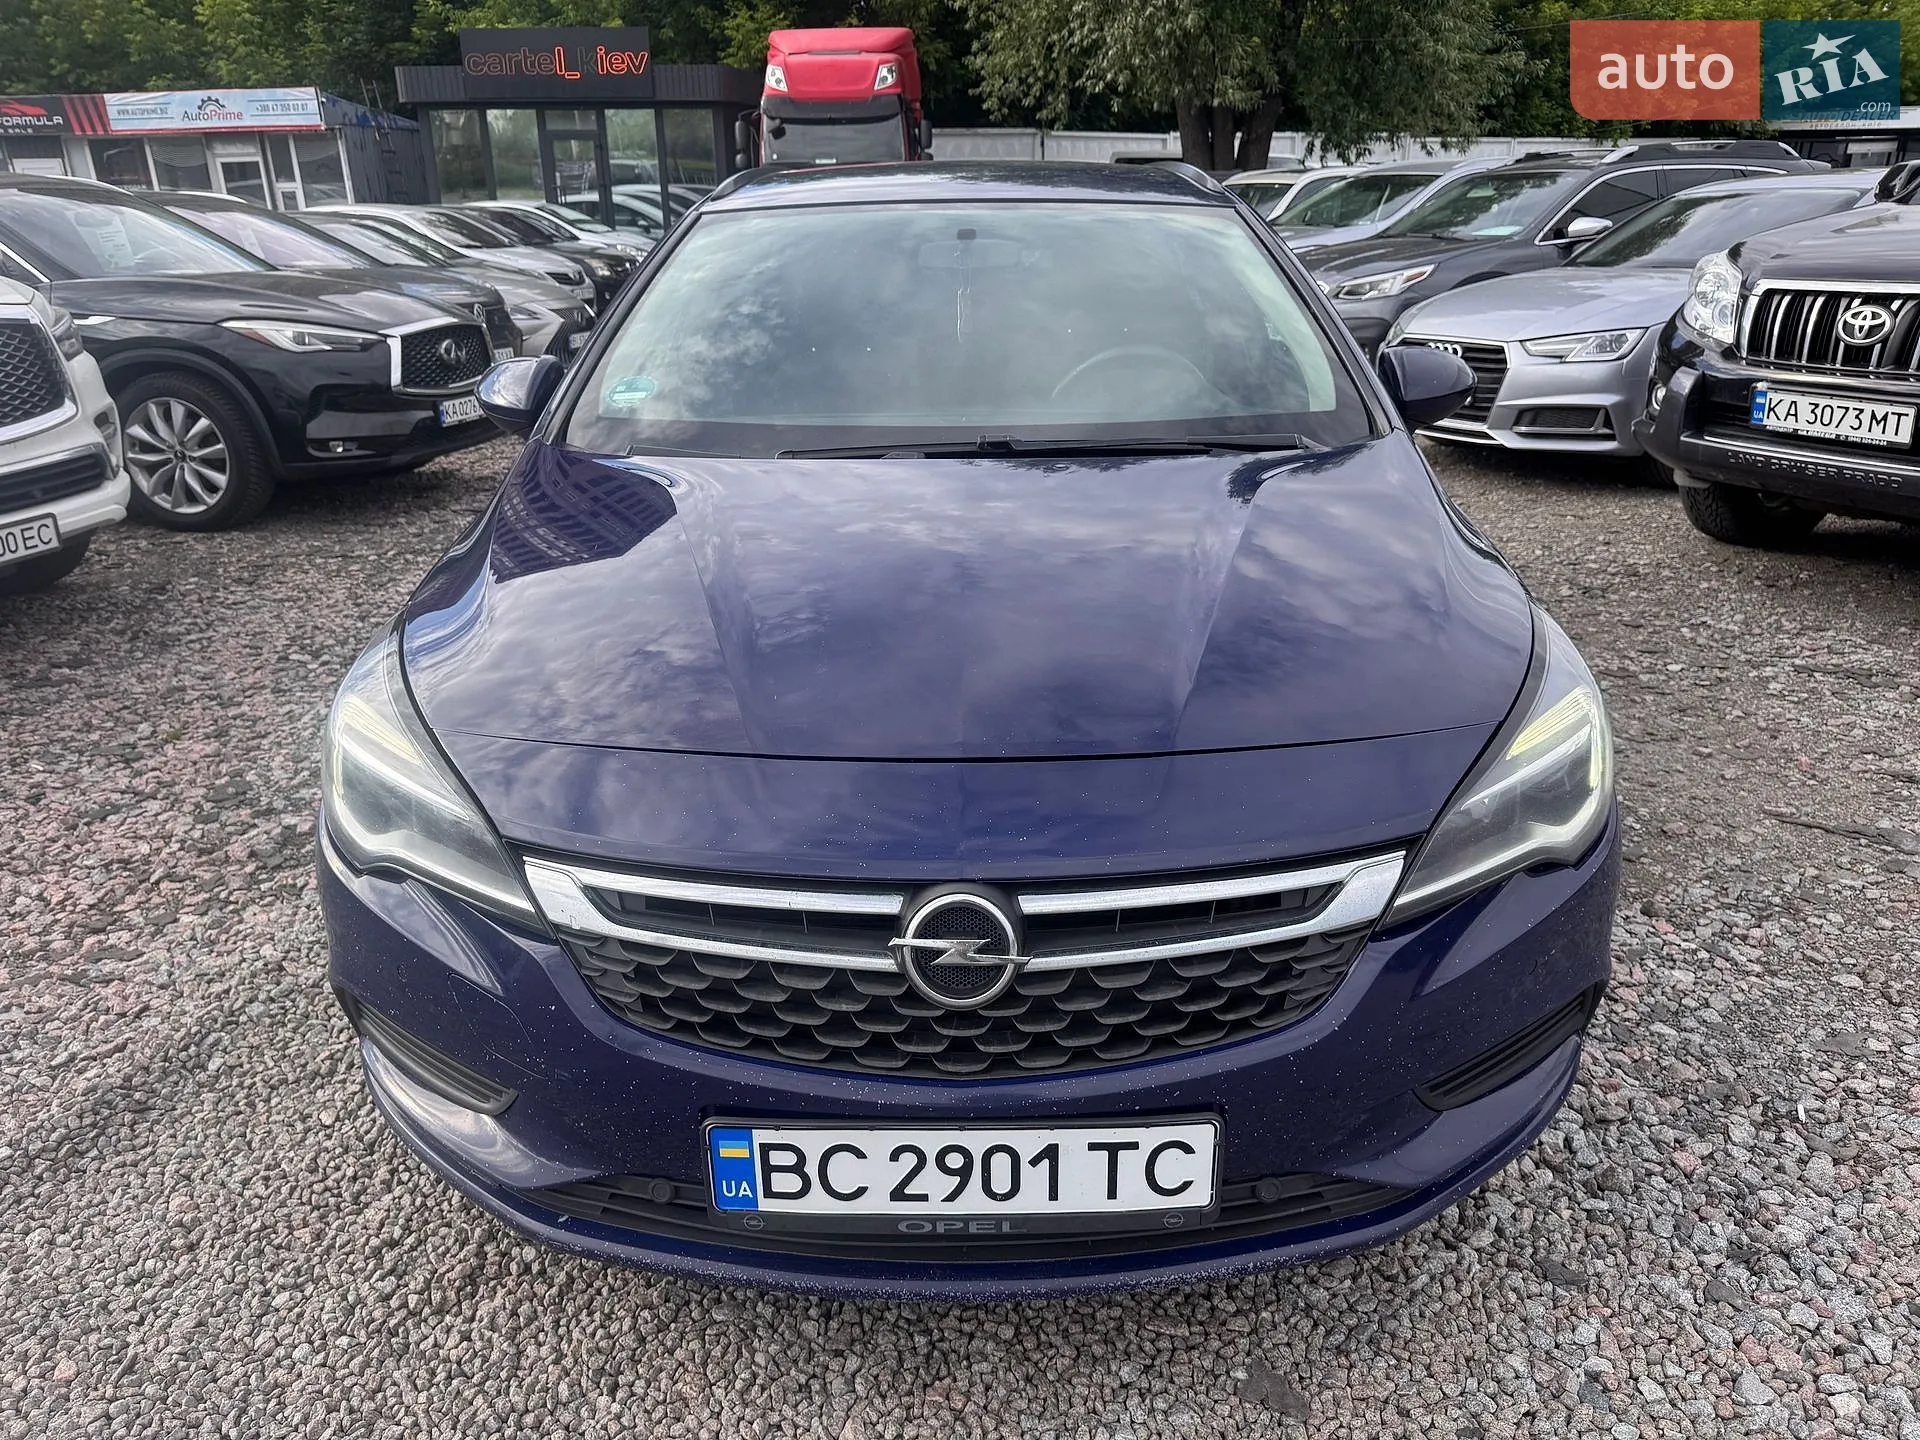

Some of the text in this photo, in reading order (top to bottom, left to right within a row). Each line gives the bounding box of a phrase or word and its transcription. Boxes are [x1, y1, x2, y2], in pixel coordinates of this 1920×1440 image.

[182, 109, 244, 122] AutoPrime
[1766, 397, 1799, 424] KA
[1805, 402, 1865, 431] 3073
[1867, 409, 1909, 437] MT
[20, 523, 52, 551] EC
[758, 1139, 1197, 1203] BC 2901 TC
[722, 1180, 753, 1198] UA
[897, 1219, 1028, 1234] OPEL
